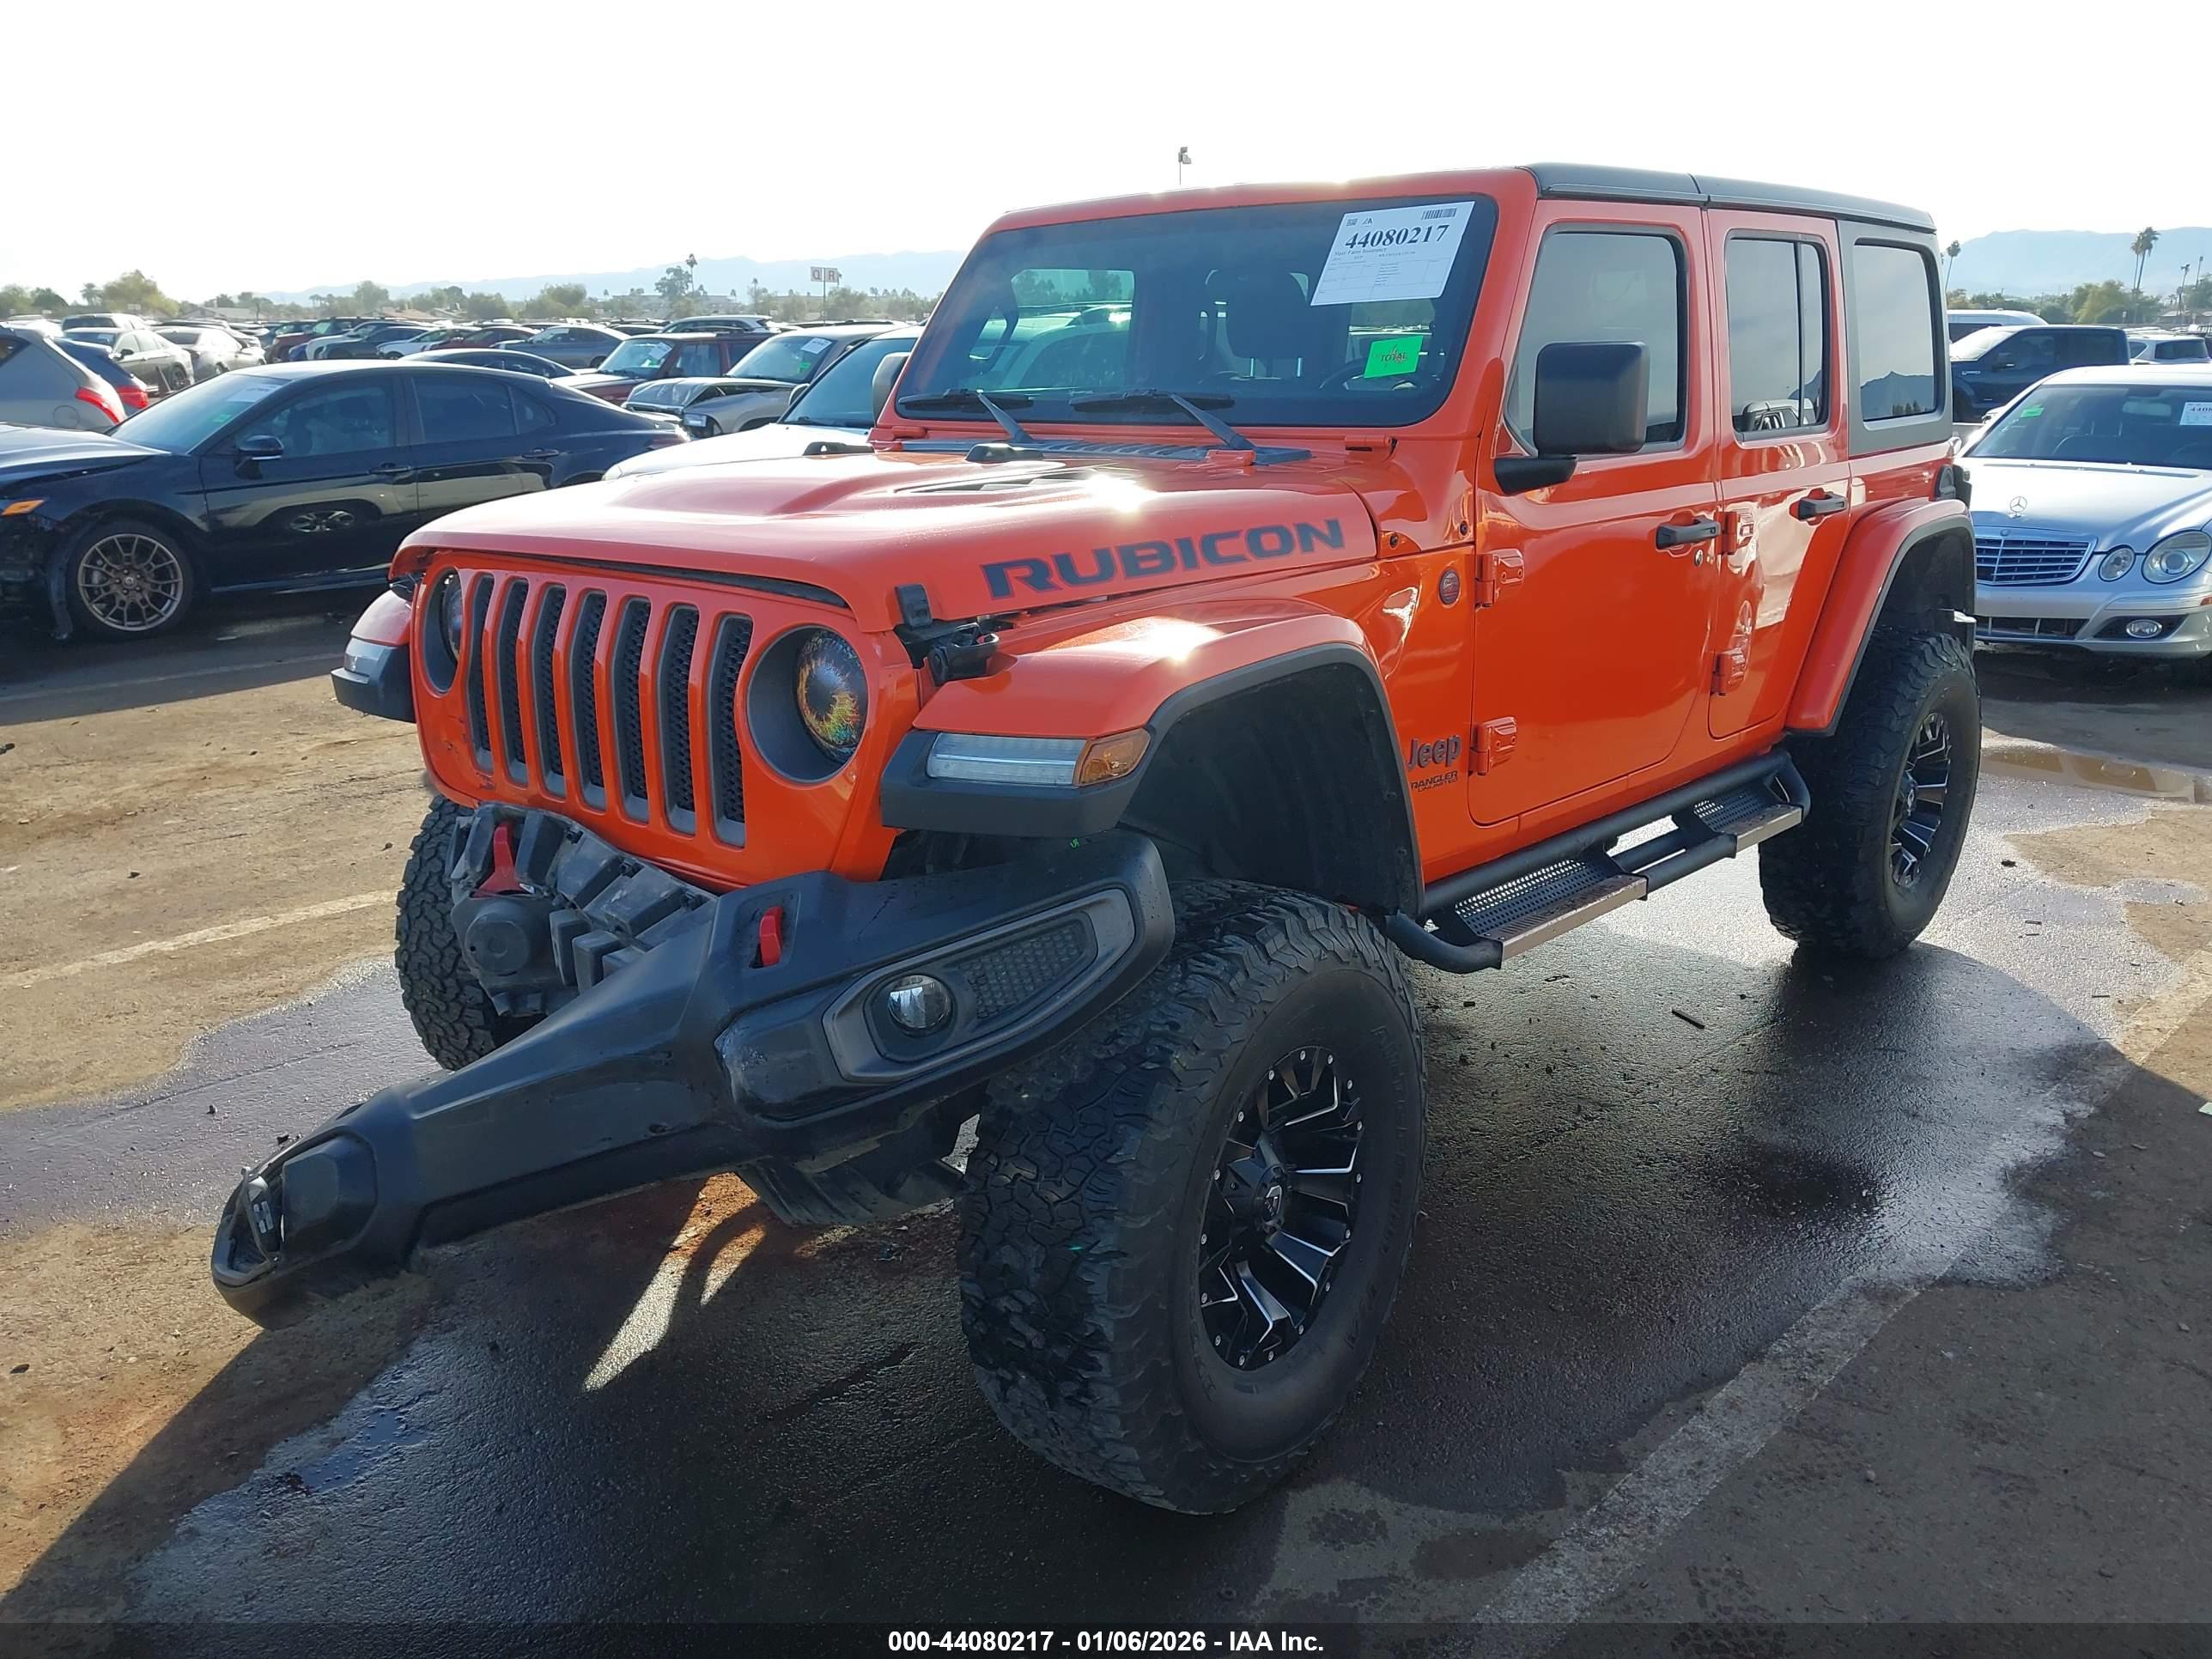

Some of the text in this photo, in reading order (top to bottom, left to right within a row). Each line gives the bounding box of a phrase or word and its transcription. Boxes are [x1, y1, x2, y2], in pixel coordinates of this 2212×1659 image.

[1345, 224, 1449, 249] 44080217
[828, 270, 836, 281] R
[980, 517, 1346, 601] RUBICON
[1408, 735, 1462, 771] Jeep
[1409, 770, 1458, 790] RANGLER
